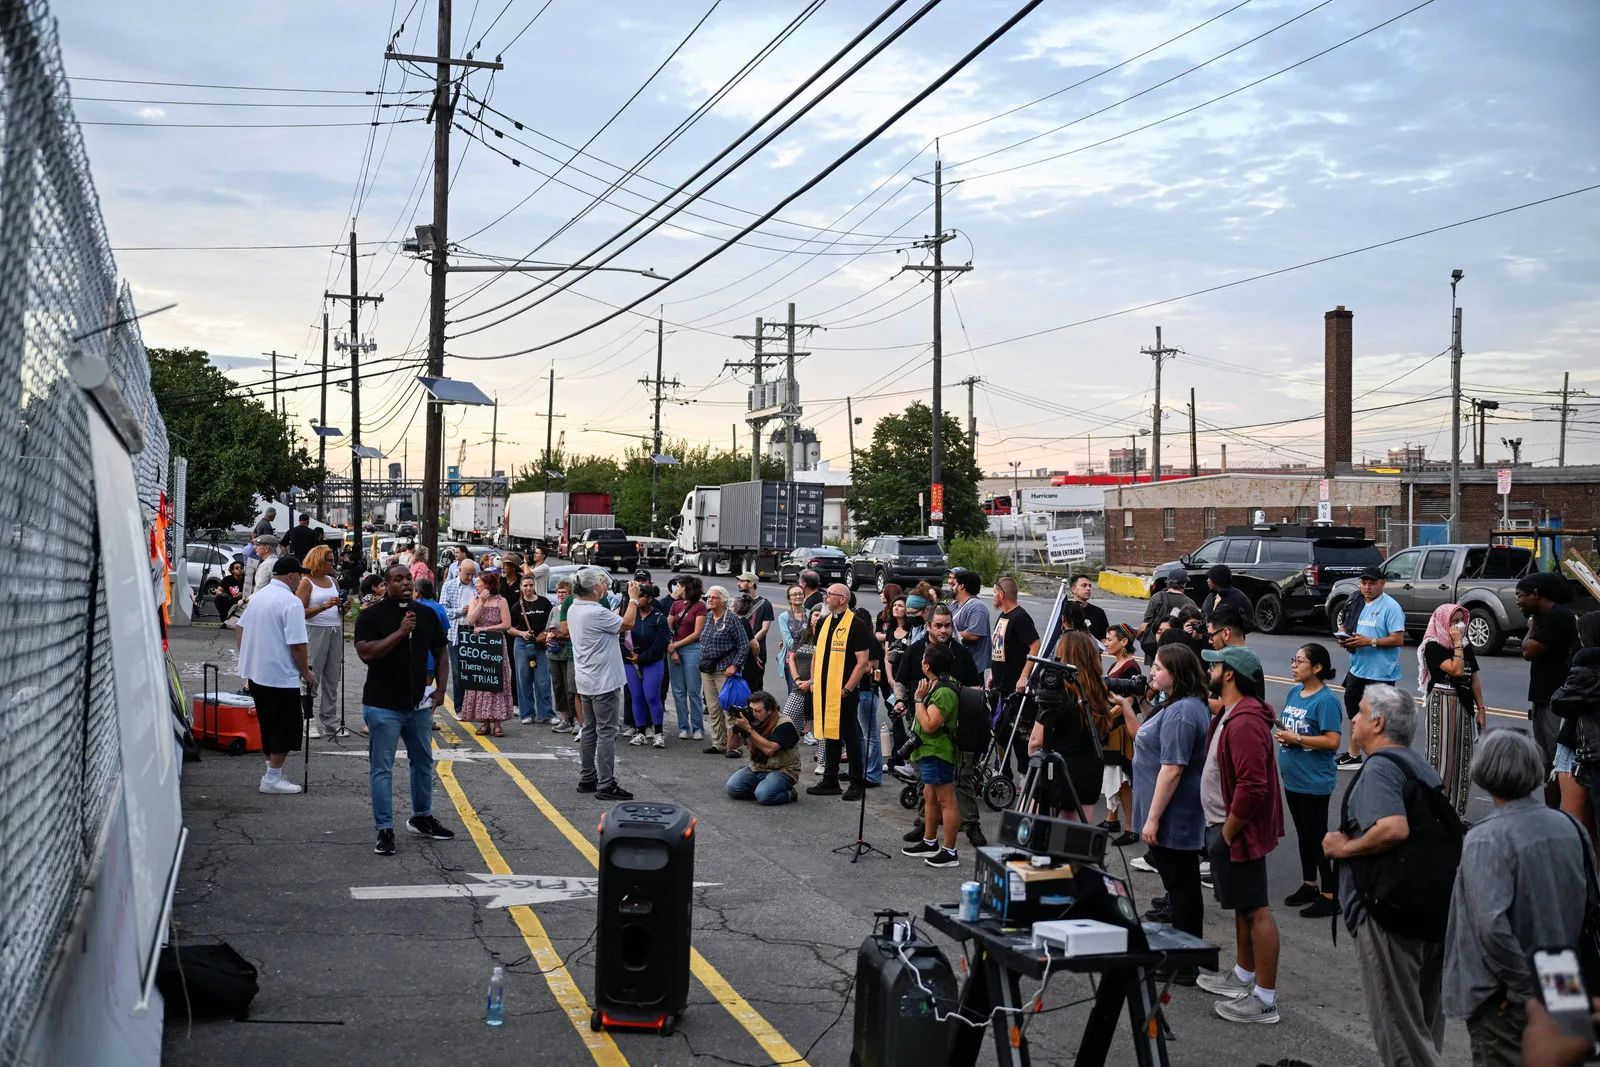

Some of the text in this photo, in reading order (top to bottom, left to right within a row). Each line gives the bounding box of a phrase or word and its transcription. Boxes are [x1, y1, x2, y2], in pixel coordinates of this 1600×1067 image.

[1062, 548, 1084, 556] ENTRANCE
[460, 631, 487, 645] ICE
[459, 645, 503, 663] GEO Group
[460, 659, 496, 674] There will
[461, 672, 499, 685] be TRIALS
